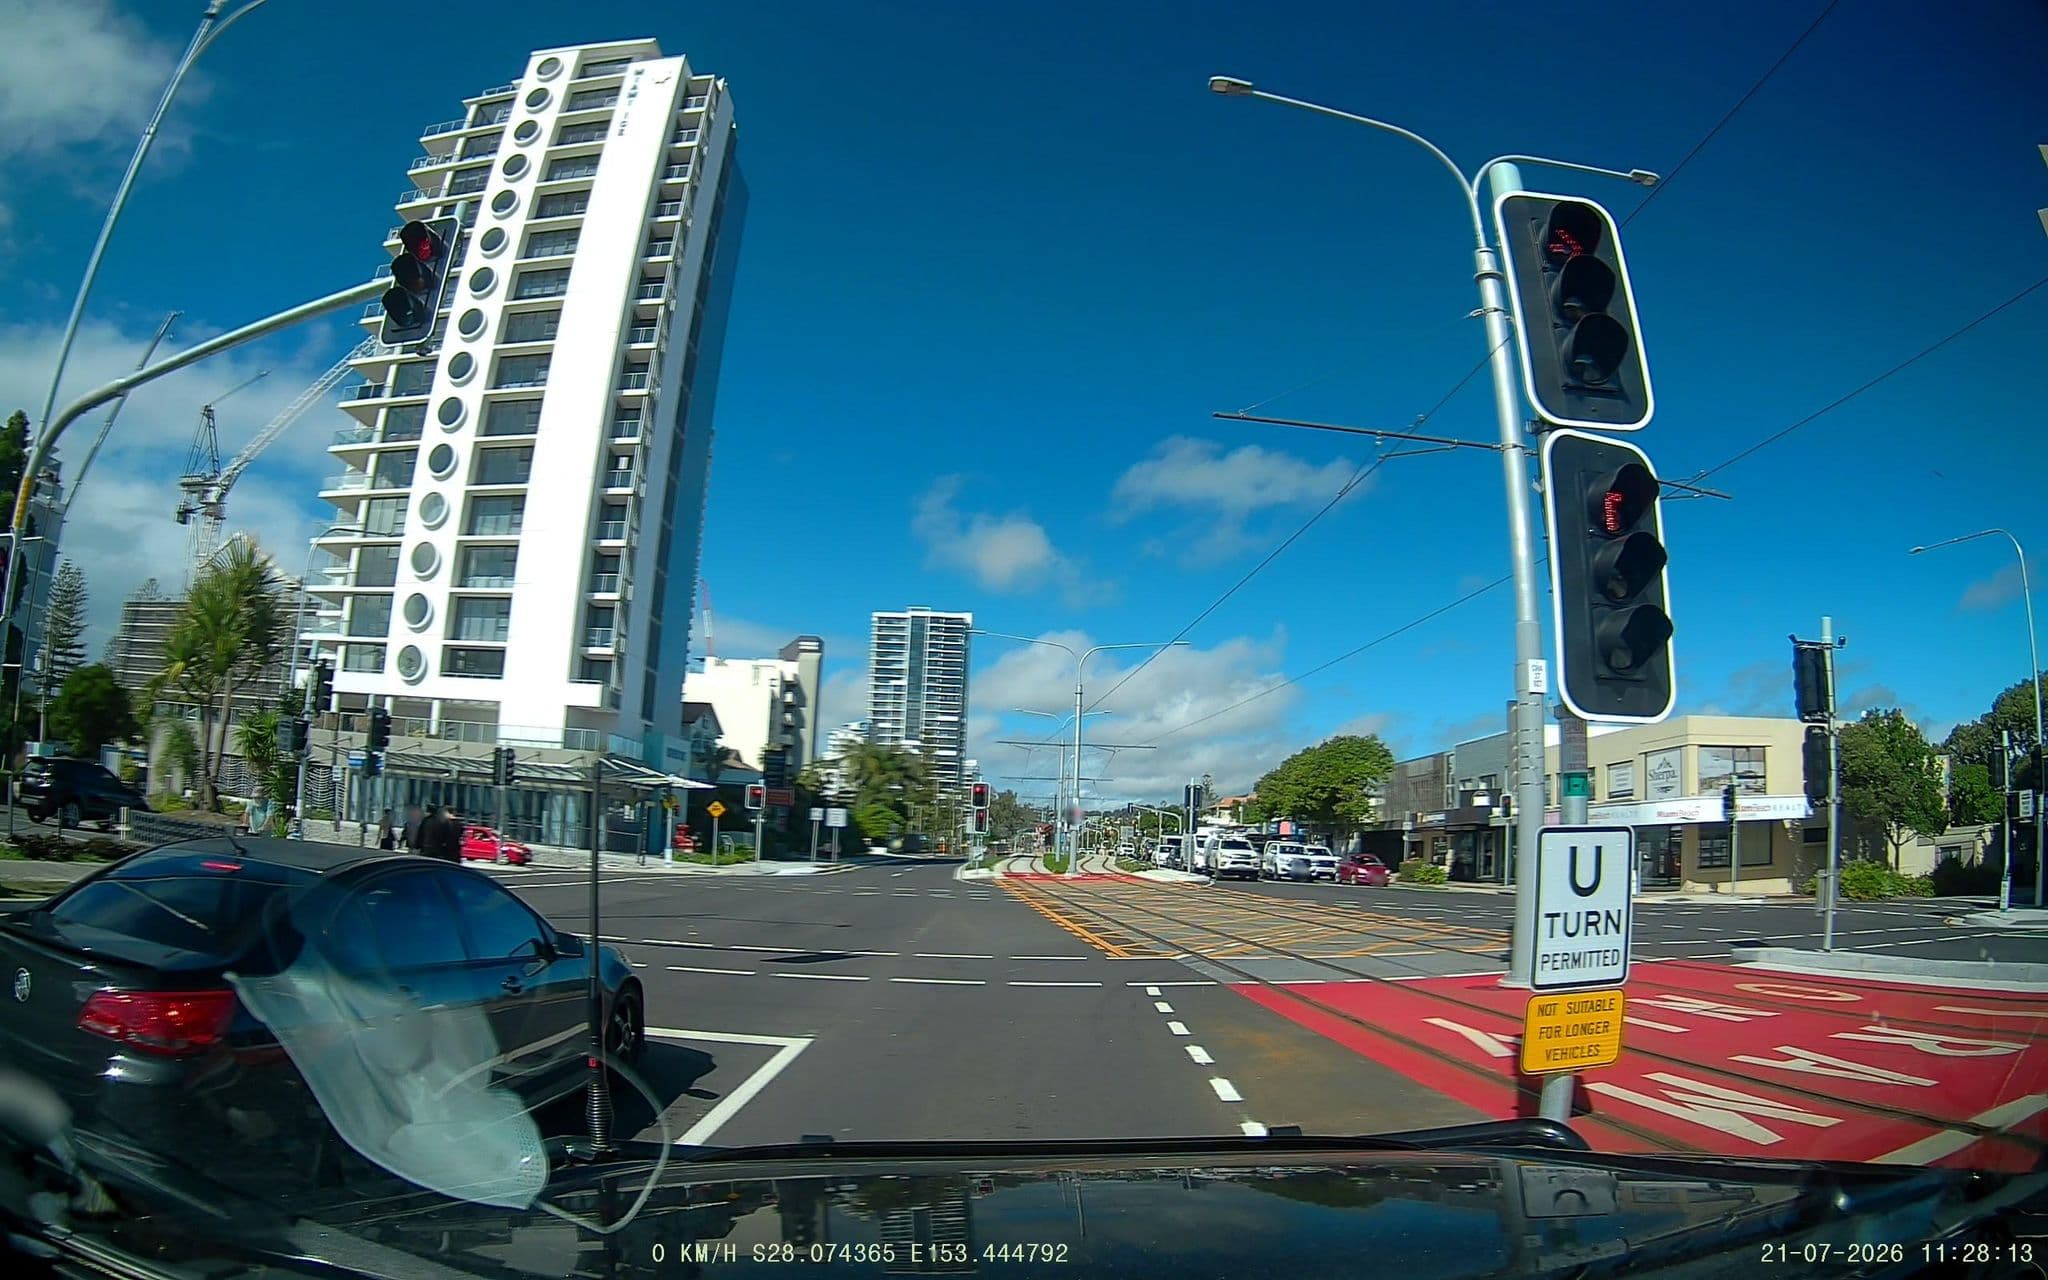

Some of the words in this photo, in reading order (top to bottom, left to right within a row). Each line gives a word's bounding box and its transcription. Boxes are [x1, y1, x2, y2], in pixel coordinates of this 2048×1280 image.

[1569, 845, 1603, 897] U
[1544, 909, 1622, 938] TURN
[1541, 949, 1620, 972] PERMITTED
[1537, 1002, 1559, 1017] NOT
[1566, 998, 1615, 1014] SUITABLE
[1539, 1025, 1562, 1040] FOR
[1565, 1021, 1610, 1038] LONGER
[1545, 1043, 1600, 1061] VEHICLES
